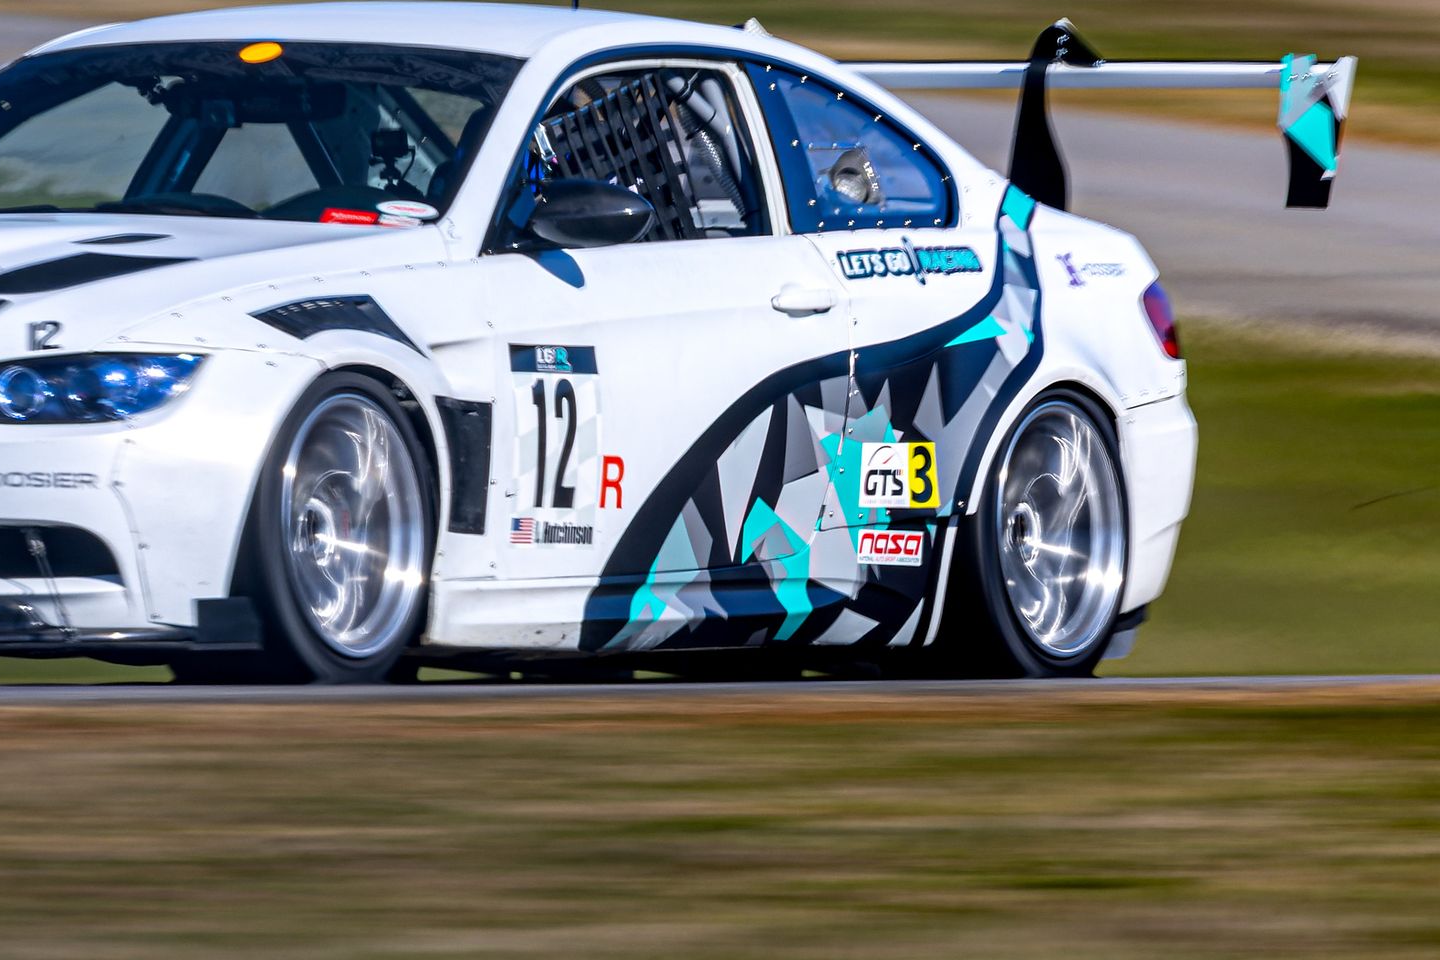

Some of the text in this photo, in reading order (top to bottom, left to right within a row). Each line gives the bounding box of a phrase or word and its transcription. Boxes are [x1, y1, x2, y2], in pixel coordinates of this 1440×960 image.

[839, 251, 887, 278] LETS
[882, 249, 913, 275] GO
[27, 320, 62, 351] 12
[531, 378, 577, 508] 12
[599, 455, 625, 509] R
[864, 446, 933, 503] GTS 3
[859, 533, 922, 555] nasa
